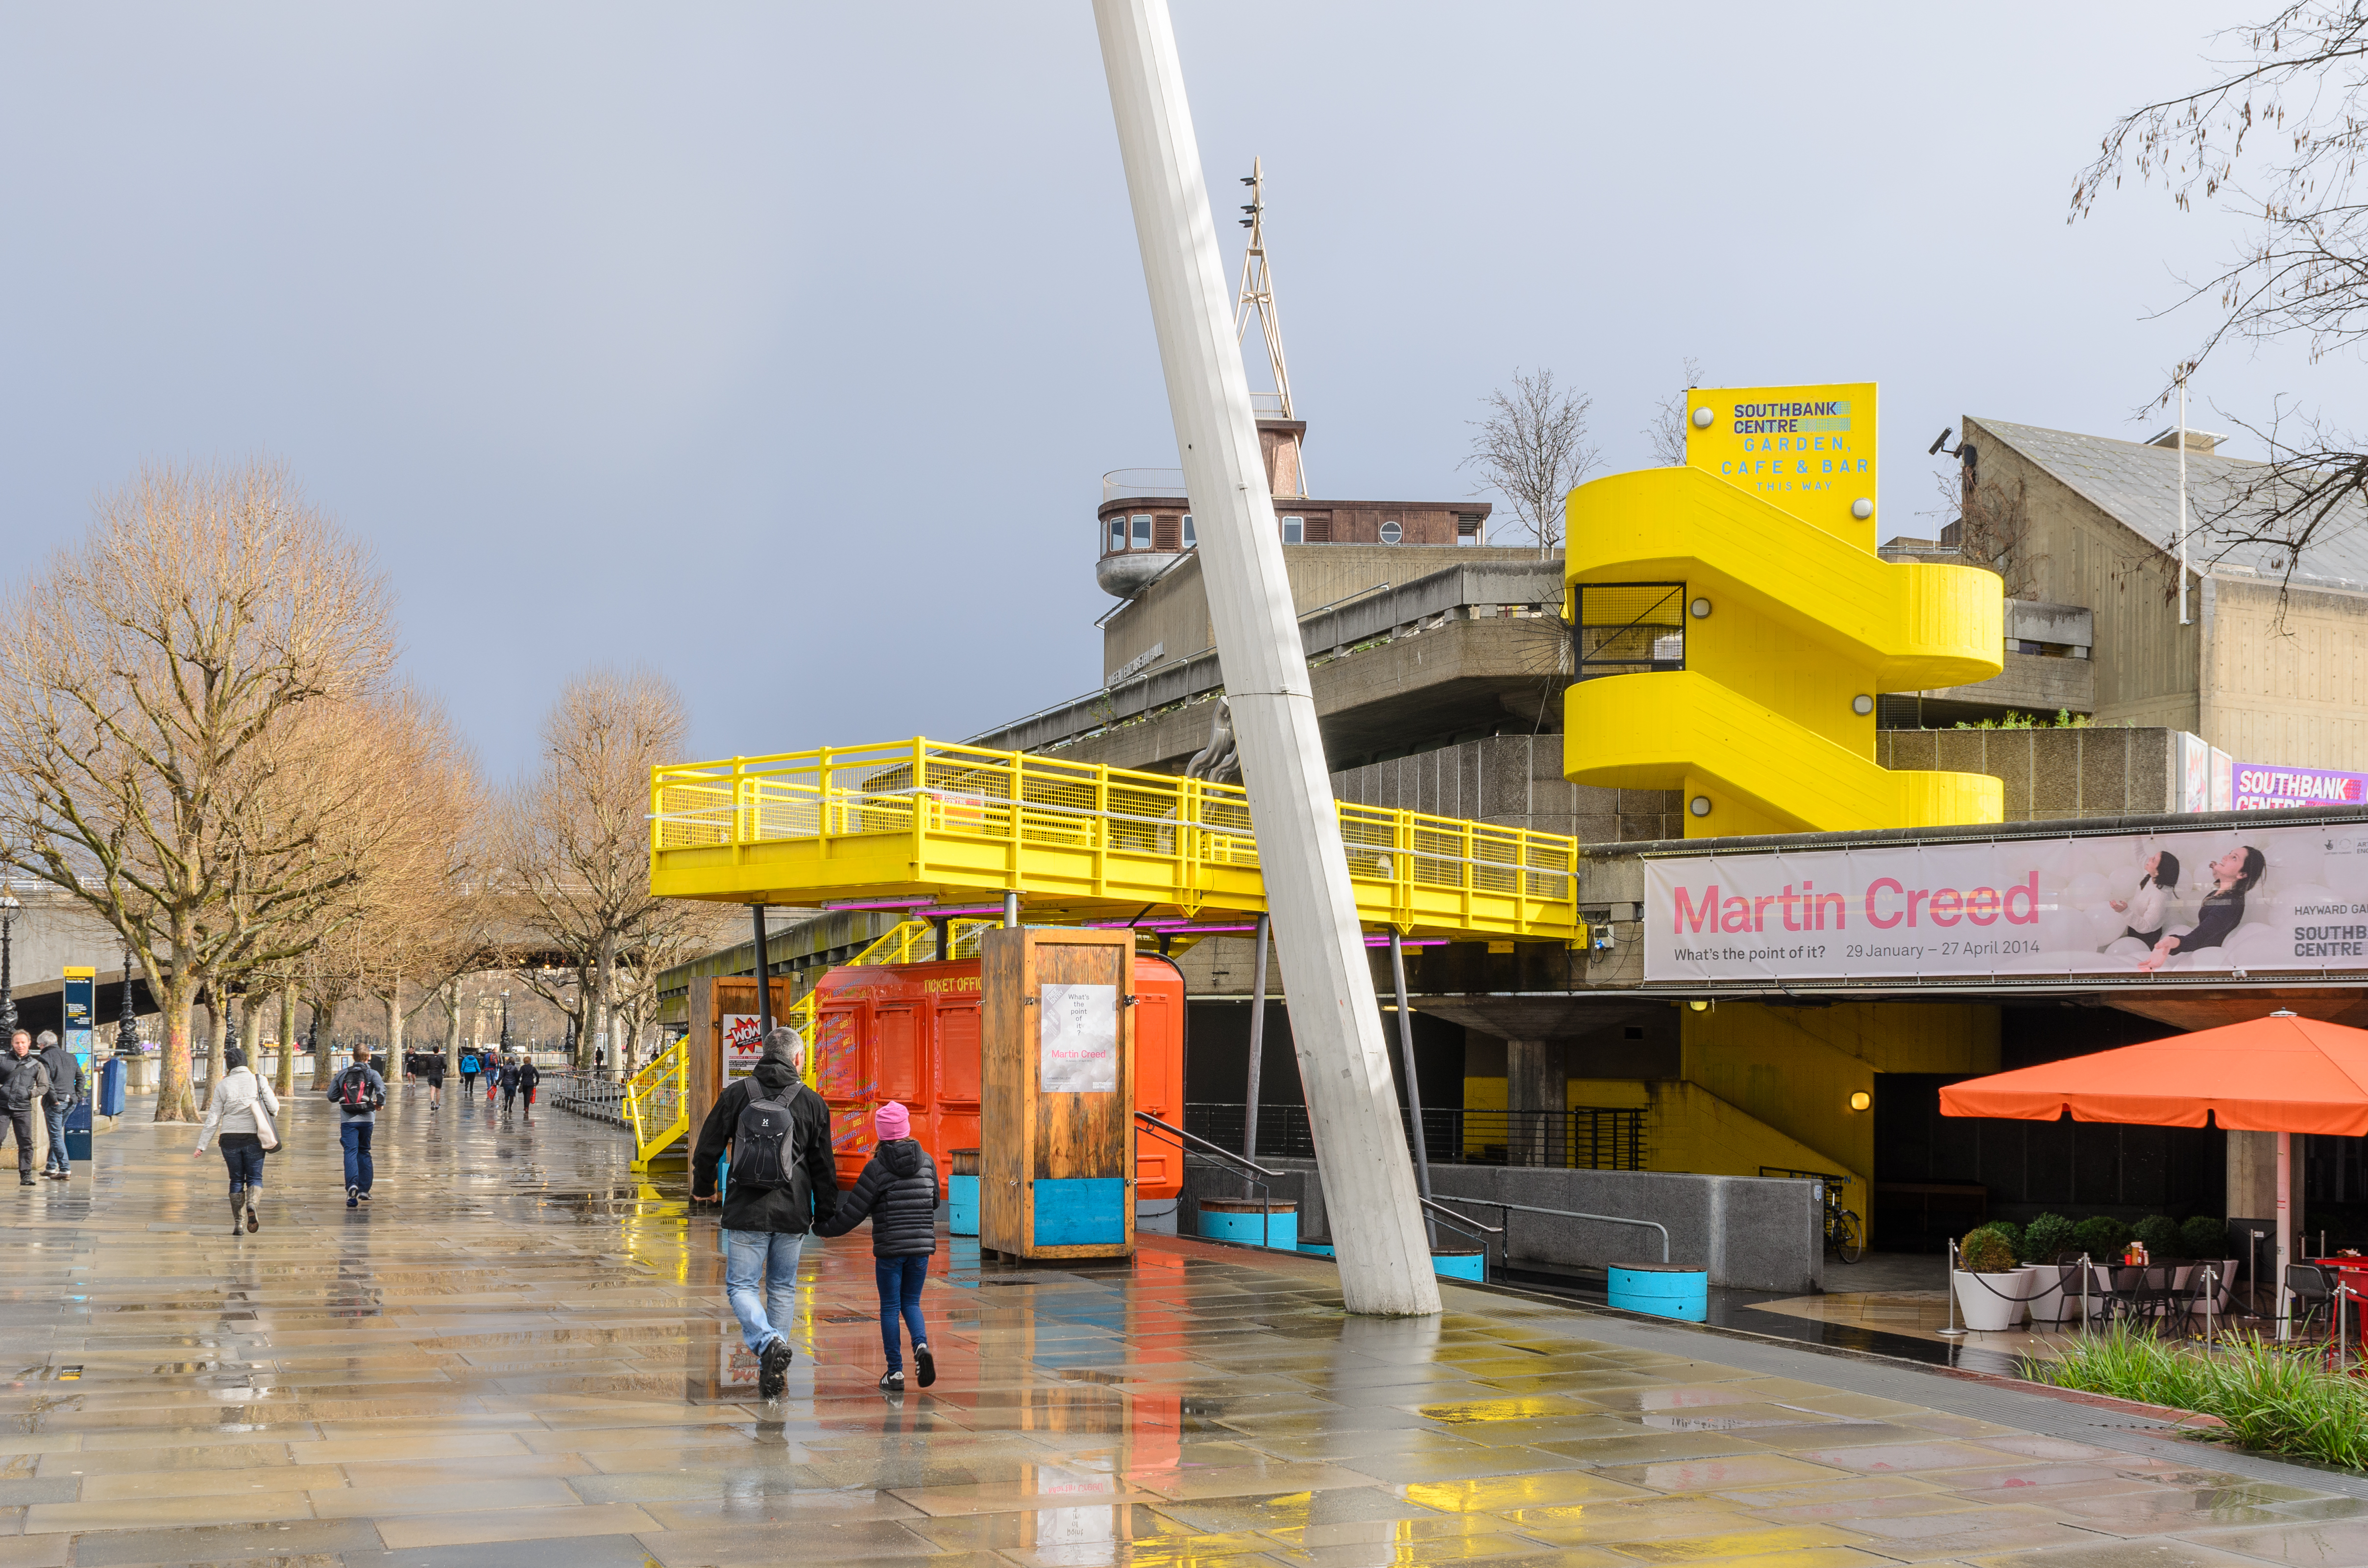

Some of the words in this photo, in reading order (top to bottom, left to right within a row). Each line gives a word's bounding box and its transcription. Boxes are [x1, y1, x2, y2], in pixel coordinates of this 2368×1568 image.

[1734, 402, 1837, 418] SOUTHBANK
[1734, 419, 1798, 434] CENTRE
[1744, 436, 1851, 453] GARDEN,
[1721, 460, 1783, 475] CAFE
[1796, 459, 1808, 474] &
[1822, 458, 1868, 474] BAR
[1757, 482, 1792, 491] THIS
[1802, 481, 1832, 491] WAY
[1107, 668, 1123, 686] QUEEN
[1124, 650, 1150, 679] ELIZABETH
[1150, 641, 1165, 662] HALL
[2239, 770, 2348, 800] SOUTHBANK
[1674, 881, 1846, 935] Martin
[1866, 870, 2039, 929] Creed
[2295, 905, 2347, 916] HAYWARD
[2351, 904, 2368, 914] GA
[2295, 925, 2368, 941] SOUTHB
[1674, 947, 1719, 961] What's
[1723, 946, 1745, 960] the
[1749, 945, 1784, 962] point
[1788, 945, 1804, 959] of
[1807, 945, 1826, 959] it?
[1846, 944, 1862, 958] 29
[1866, 943, 1924, 959] January
[1941, 941, 1959, 956] 27
[1963, 941, 1999, 958] April
[2002, 940, 2040, 954] 2014
[2295, 941, 2363, 957] CENTRE
[924, 978, 955, 993] TICKET
[957, 976, 981, 992] OFFIC
[1046, 988, 1058, 1001] FREE
[1050, 989, 1064, 1004] ENTRY
[823, 1014, 840, 1030] THEATRE
[839, 1019, 849, 1029] GIGS
[731, 1022, 761, 1041] WOW
[1051, 1049, 1078, 1058] Martin
[1081, 1049, 1106, 1058] Creed
[843, 1110, 860, 1122] THEATRE
[853, 1118, 862, 1127] GIGS
[831, 1129, 857, 1147] RESTAURANTS
[857, 1144, 870, 1153] MUSIC
